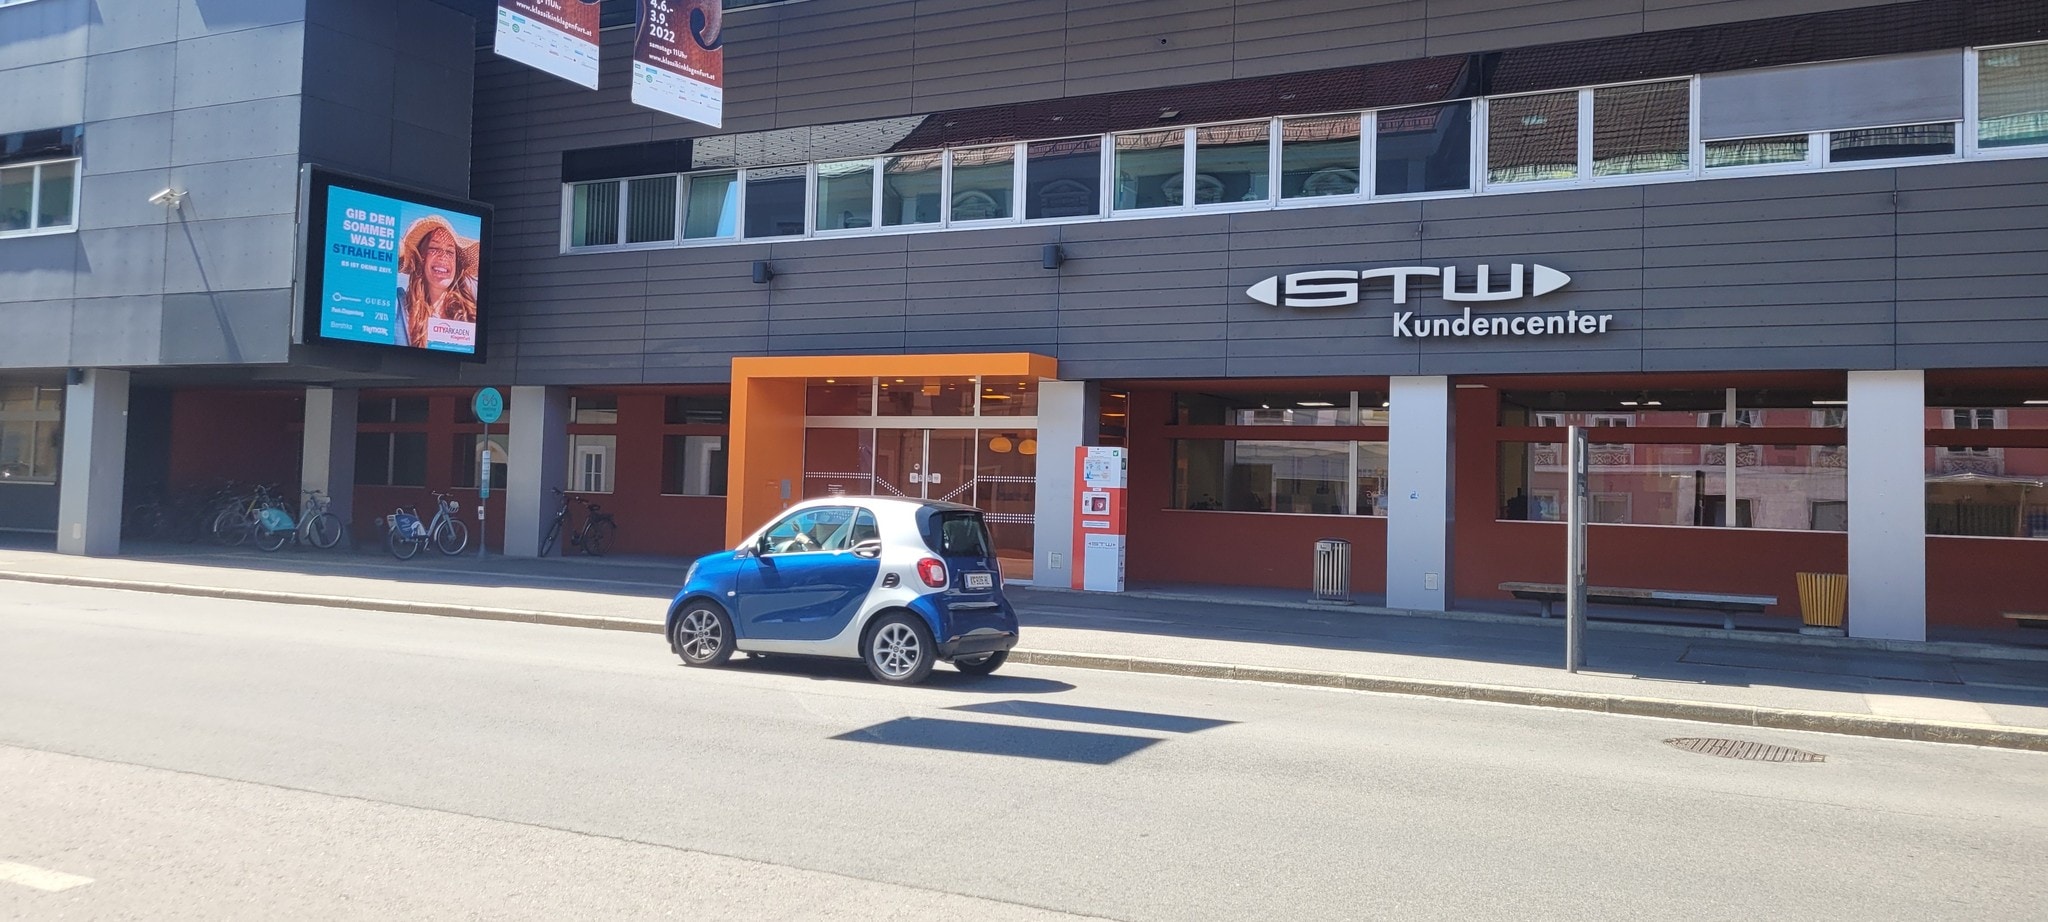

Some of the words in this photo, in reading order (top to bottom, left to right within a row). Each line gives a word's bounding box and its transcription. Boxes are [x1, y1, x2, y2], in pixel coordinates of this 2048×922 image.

[516, 1, 592, 37] www.klassikinklagenfurt.at
[650, 10, 669, 27] 3.9.
[649, 24, 676, 43] 2022
[649, 42, 673, 56] samstags
[346, 208, 366, 221] GIB
[370, 214, 395, 227] DEM
[343, 221, 395, 239] SOMMER
[350, 233, 376, 247] WAS
[378, 239, 394, 250] ZU
[332, 244, 393, 262] STRAHLEN
[1285, 263, 1524, 308] STW
[365, 297, 391, 307] GUESS
[1393, 307, 1612, 337] Kundencenter
